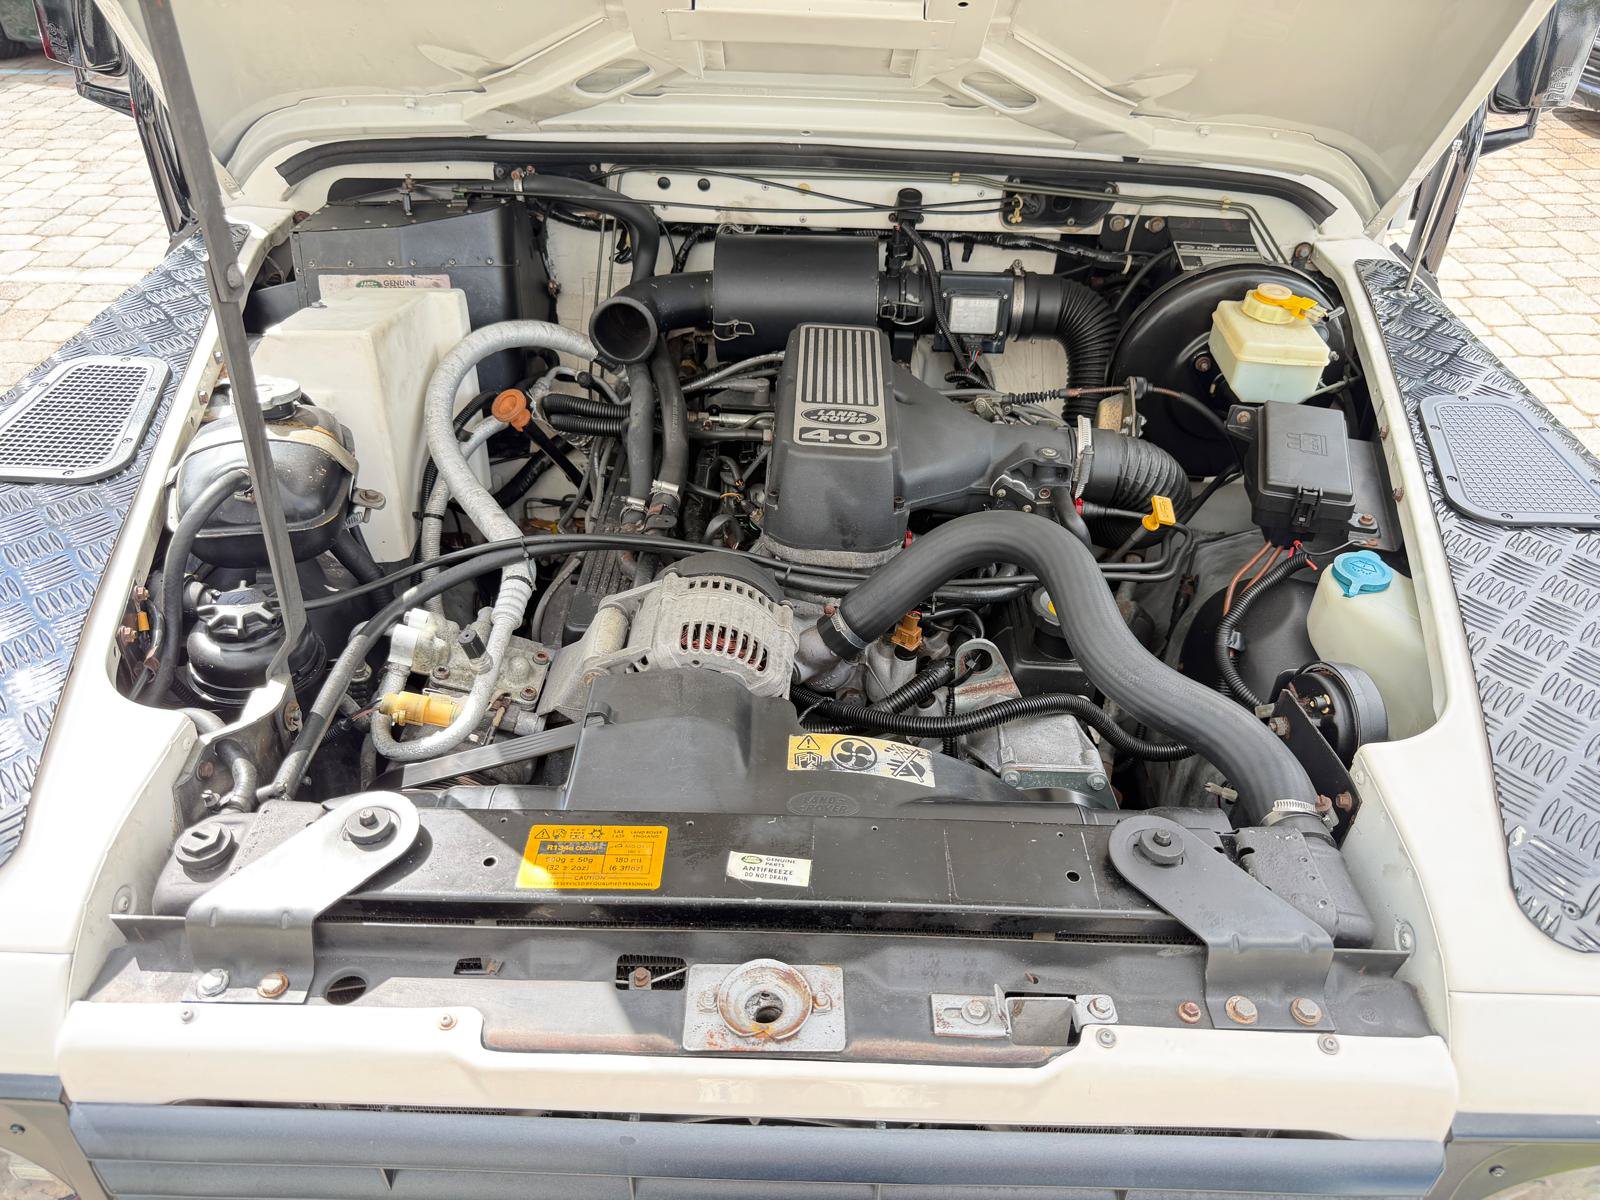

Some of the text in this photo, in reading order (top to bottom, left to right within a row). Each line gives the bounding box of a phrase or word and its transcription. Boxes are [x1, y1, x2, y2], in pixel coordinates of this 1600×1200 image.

[383, 279, 417, 287] GENUINE
[765, 856, 796, 865] GENUINE
[742, 865, 793, 876] ANTIFREEZE
[769, 874, 788, 882] DRAIN
